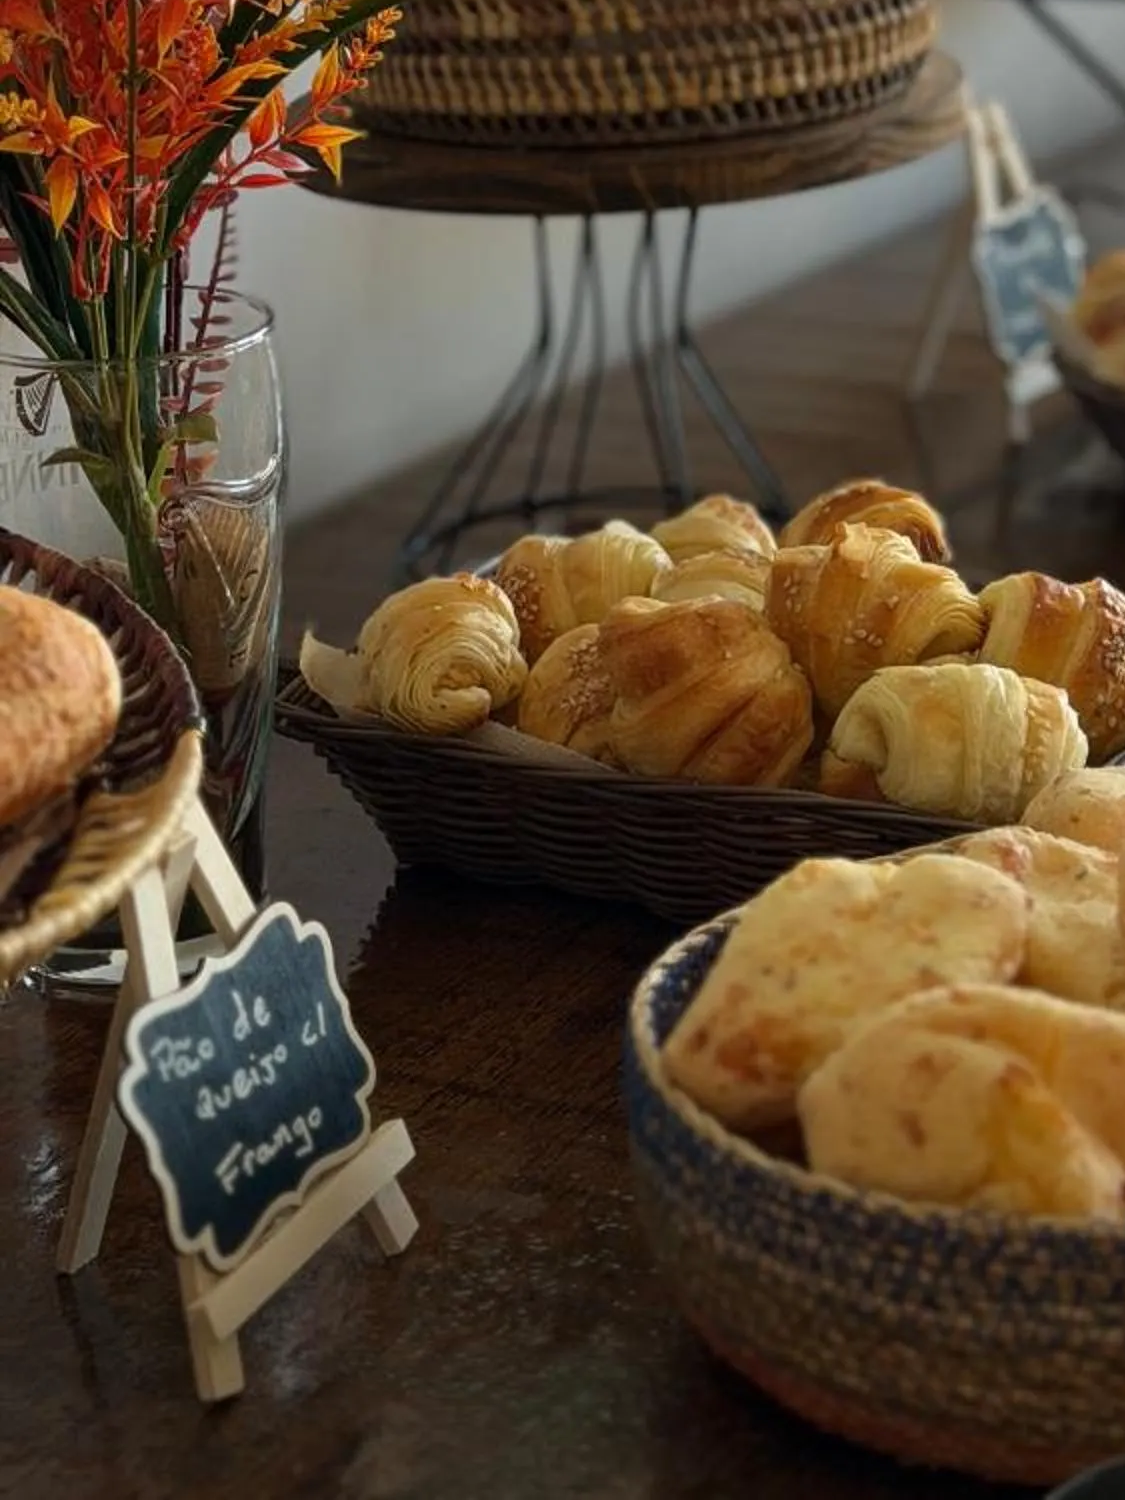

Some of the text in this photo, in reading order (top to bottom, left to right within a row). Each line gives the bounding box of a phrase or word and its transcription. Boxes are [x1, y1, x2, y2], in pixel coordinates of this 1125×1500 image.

[150, 989, 272, 1082] Pão de
[213, 1105, 323, 1196] Frango
